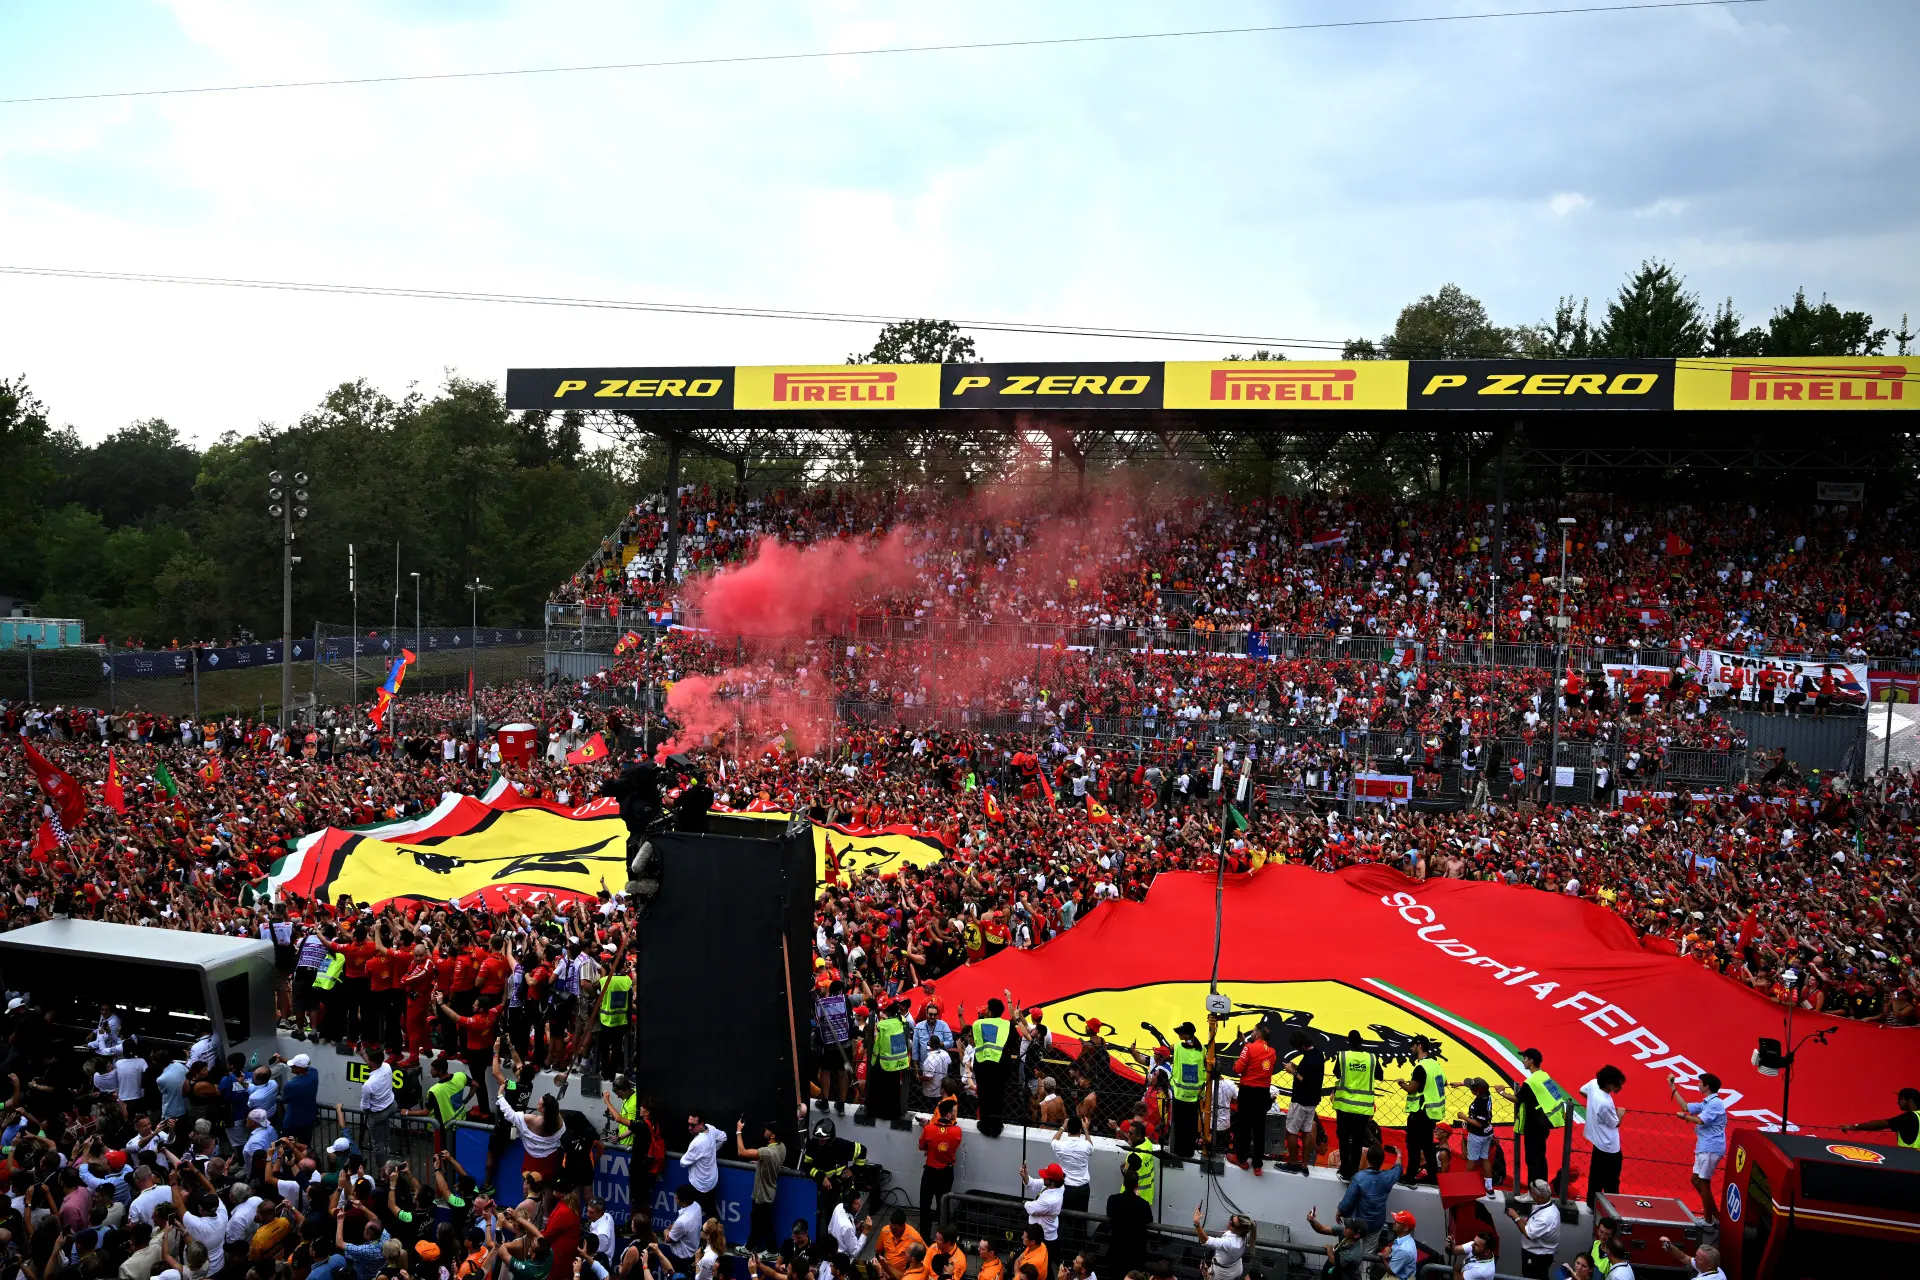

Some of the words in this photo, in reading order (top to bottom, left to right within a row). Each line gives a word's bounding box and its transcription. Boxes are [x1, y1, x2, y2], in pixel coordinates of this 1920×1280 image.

[555, 380, 587, 398] P
[593, 379, 723, 397] ZERO
[773, 372, 898, 402] PIRELLI
[952, 376, 991, 396] P
[1000, 375, 1151, 395] ZERO
[1210, 370, 1357, 401] PIRELLI
[1421, 374, 1468, 395] P
[1477, 373, 1659, 395] ZERO
[1730, 366, 1908, 401] PIRELLI
[1212, 1000, 1225, 1009] 25
[349, 1062, 404, 1089] LES
[1552, 990, 1817, 1138] FERRAR
[1727, 1186, 1741, 1217] hp
